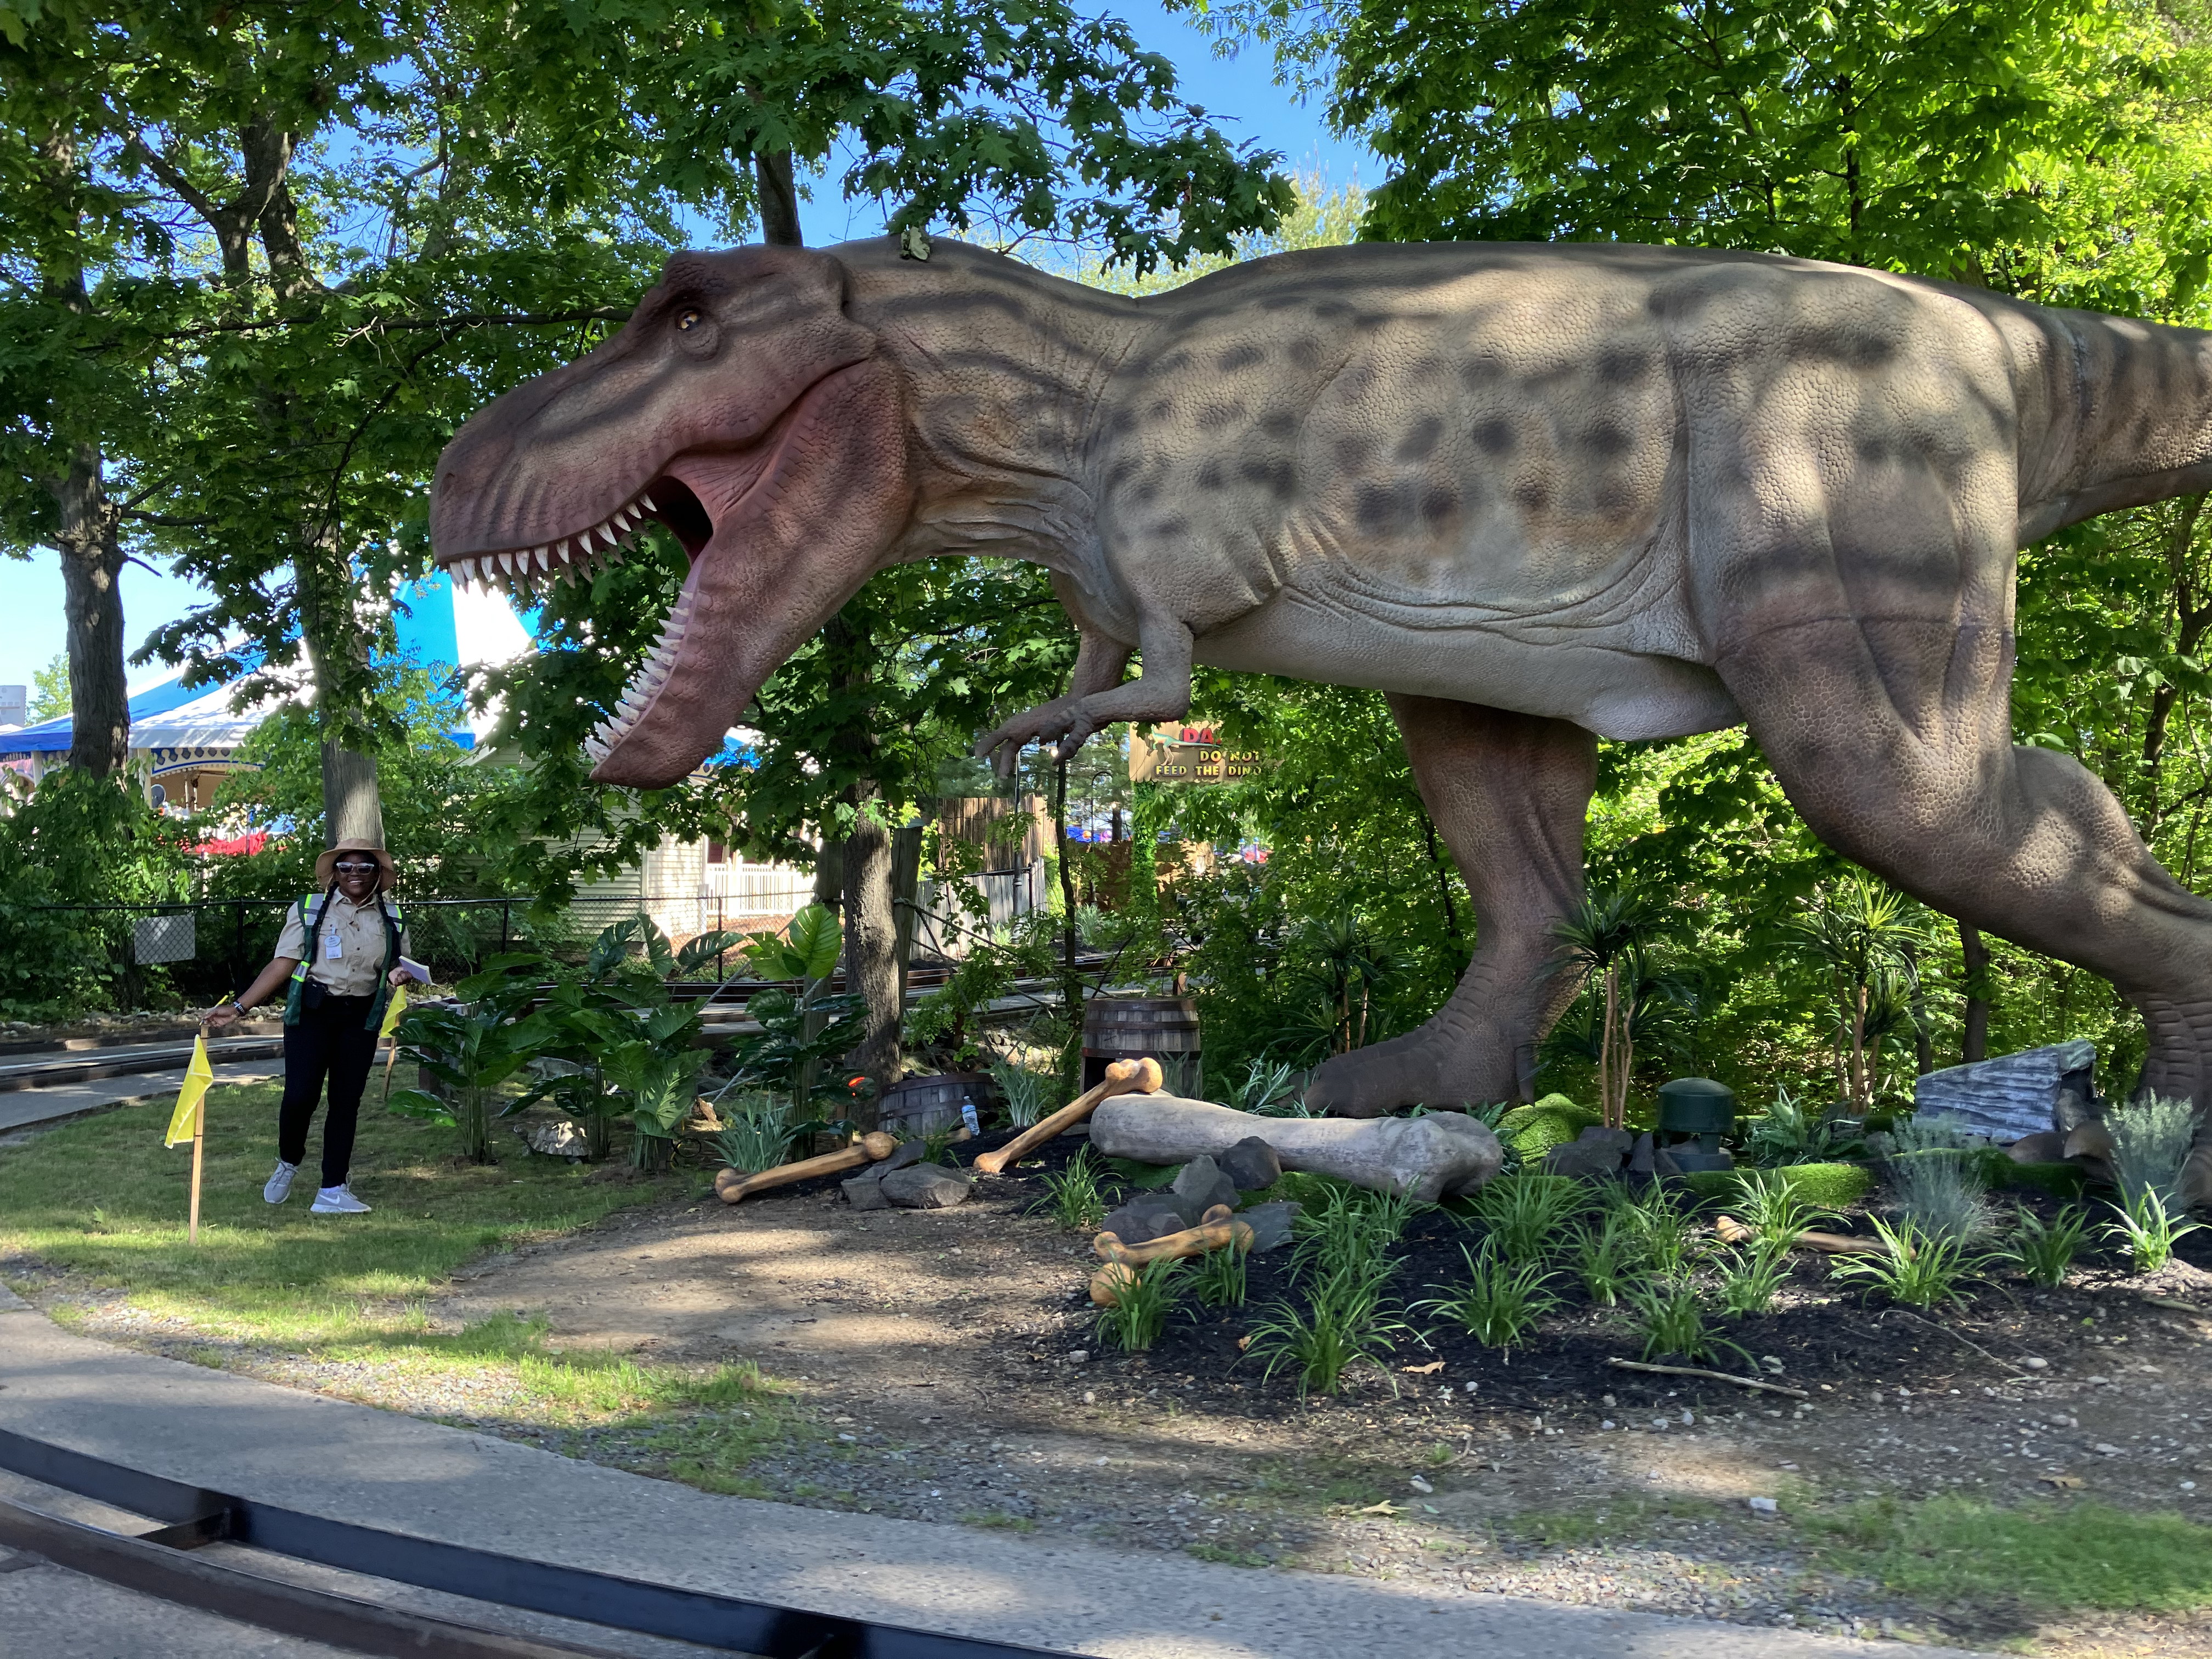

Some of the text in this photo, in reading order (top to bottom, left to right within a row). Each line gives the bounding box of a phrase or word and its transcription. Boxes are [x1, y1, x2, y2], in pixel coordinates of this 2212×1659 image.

[1200, 750, 1222, 762] DO
[1155, 765, 1187, 775] FEED
[1195, 765, 1220, 775] THE
